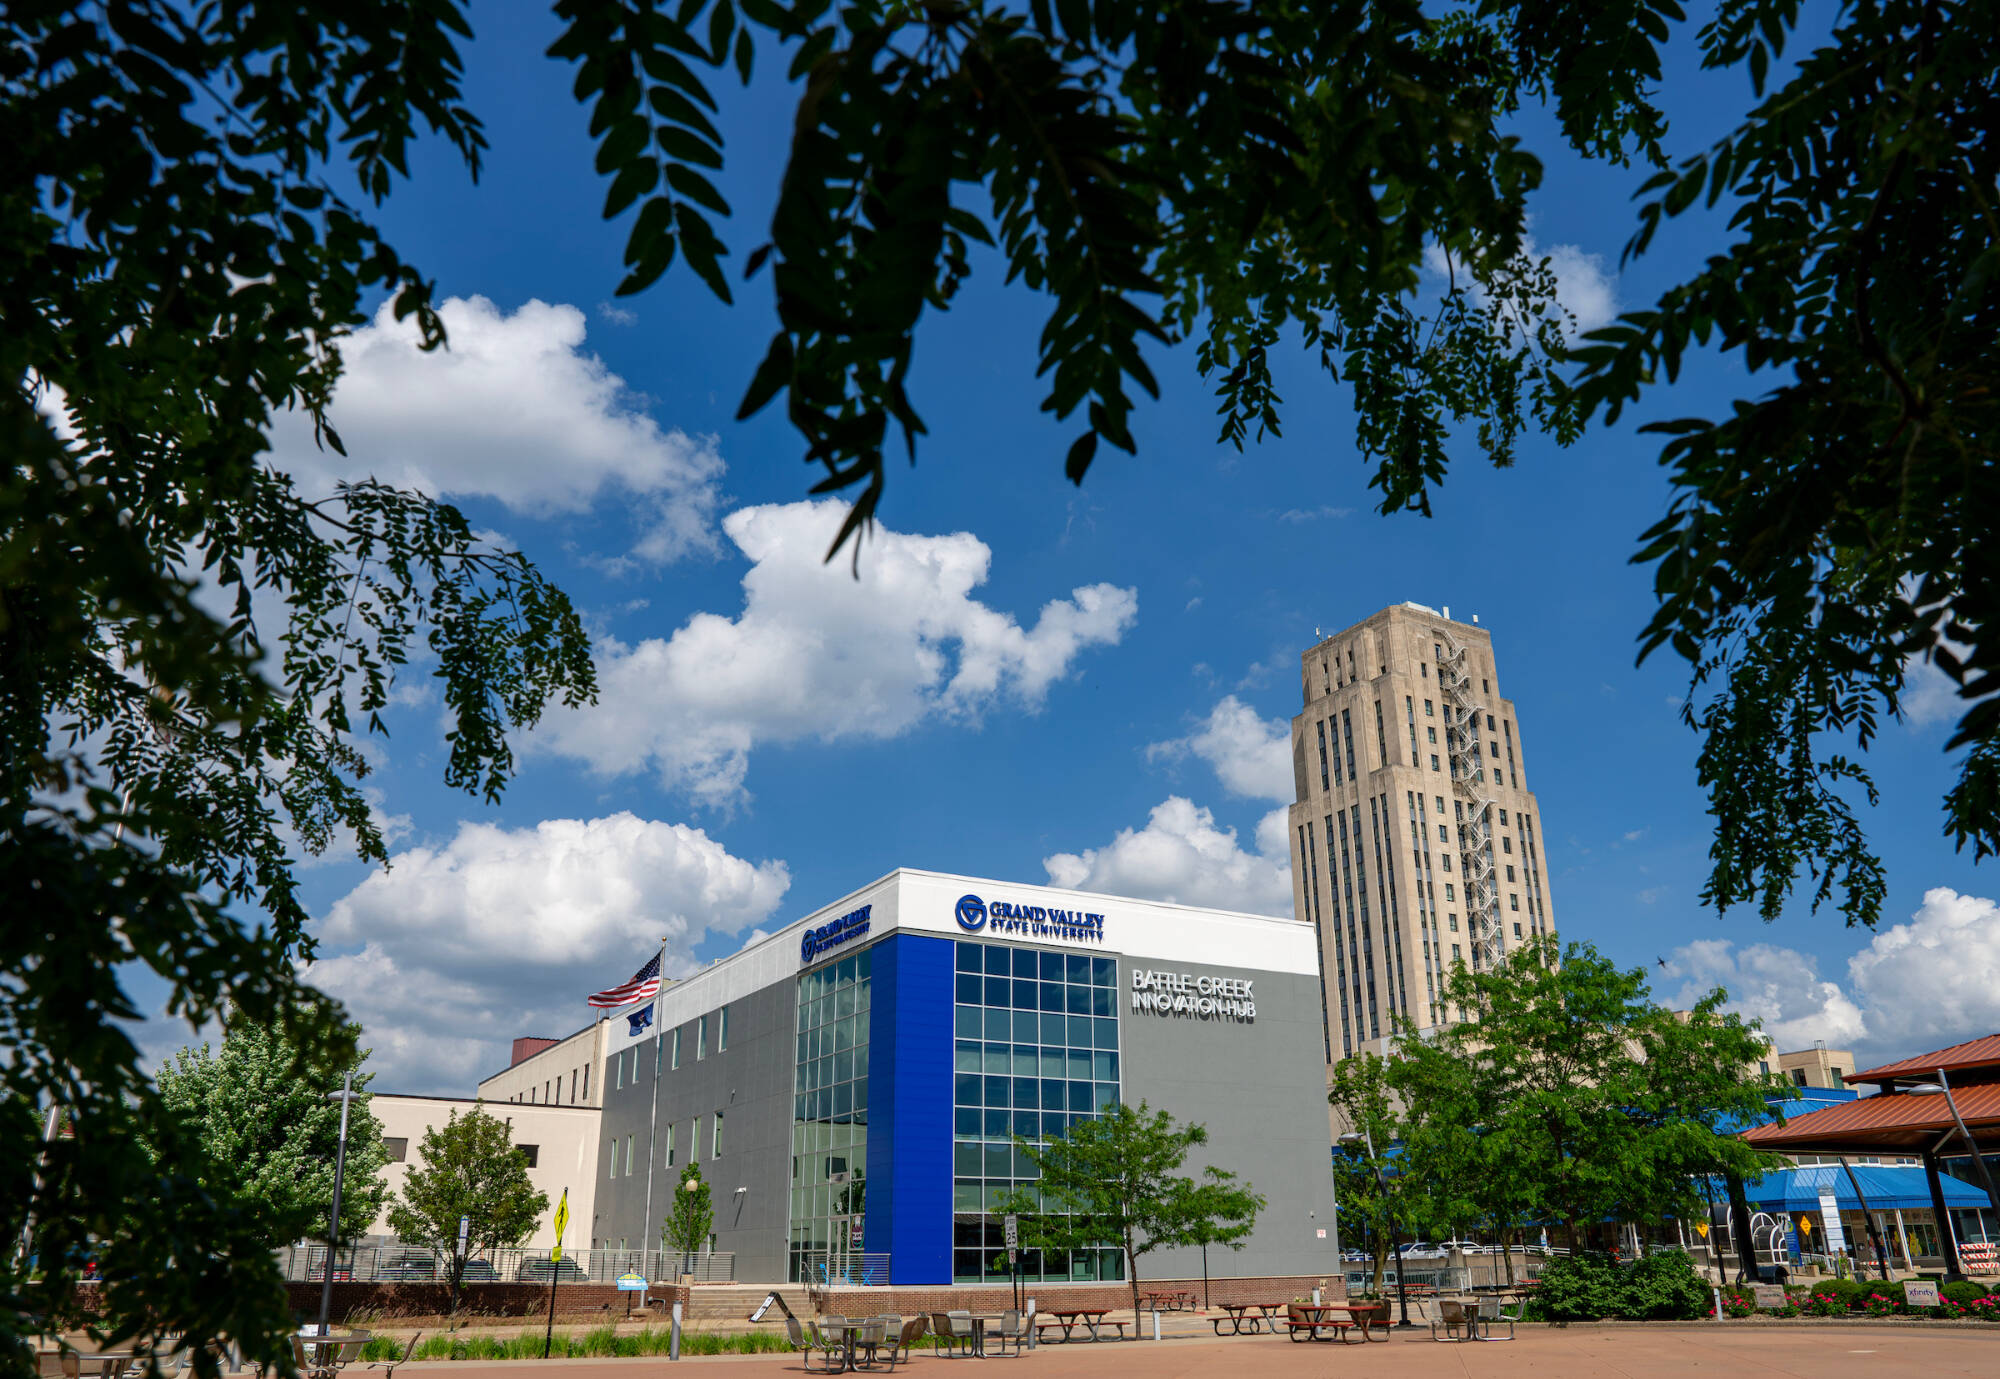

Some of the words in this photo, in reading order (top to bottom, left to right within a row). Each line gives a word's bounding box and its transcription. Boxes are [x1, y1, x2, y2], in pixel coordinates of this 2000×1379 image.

[990, 901, 1047, 922] GRAND
[1048, 908, 1105, 929] VALLEY
[990, 918, 1028, 933] STATE
[1032, 923, 1104, 941] UNIVERSITY
[1132, 969, 1192, 993] BATTLE
[1197, 975, 1255, 999] CREEK
[1132, 992, 1222, 1014] INNOVATION
[1226, 999, 1257, 1017] HUB
[1007, 1232, 1016, 1245] 25
[1908, 1287, 1934, 1297] xfinity
